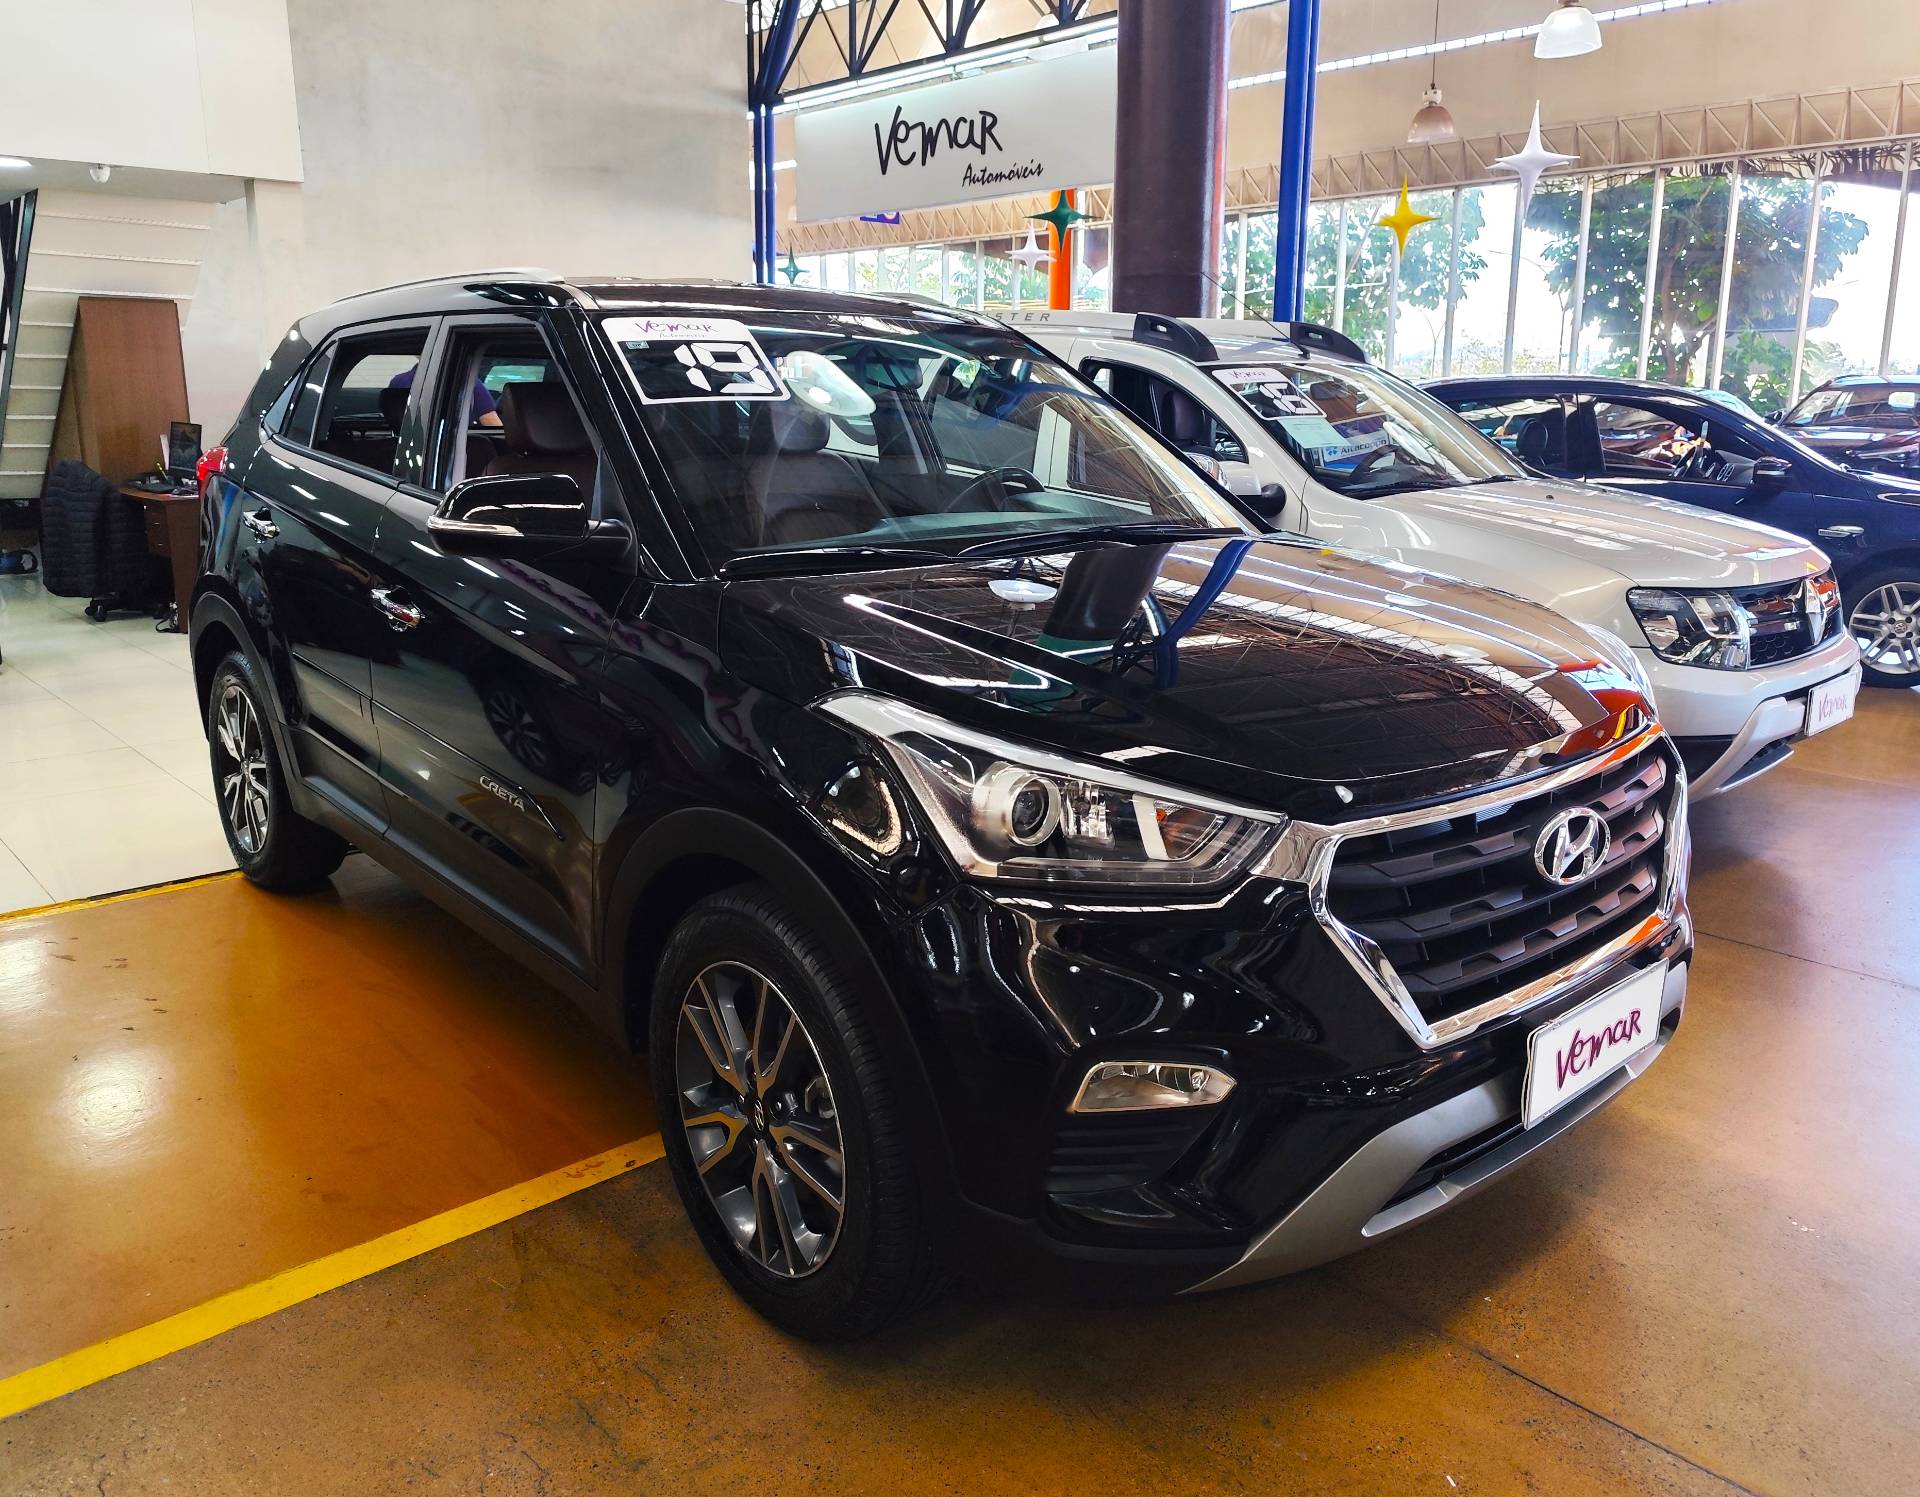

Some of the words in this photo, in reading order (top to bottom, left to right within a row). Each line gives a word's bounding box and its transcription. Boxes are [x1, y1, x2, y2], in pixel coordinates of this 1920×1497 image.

[962, 158, 1044, 187] Automóveis
[986, 312, 1050, 321] STER
[674, 343, 775, 393] 19
[1259, 383, 1319, 414] 16
[480, 775, 525, 812] CRETA
